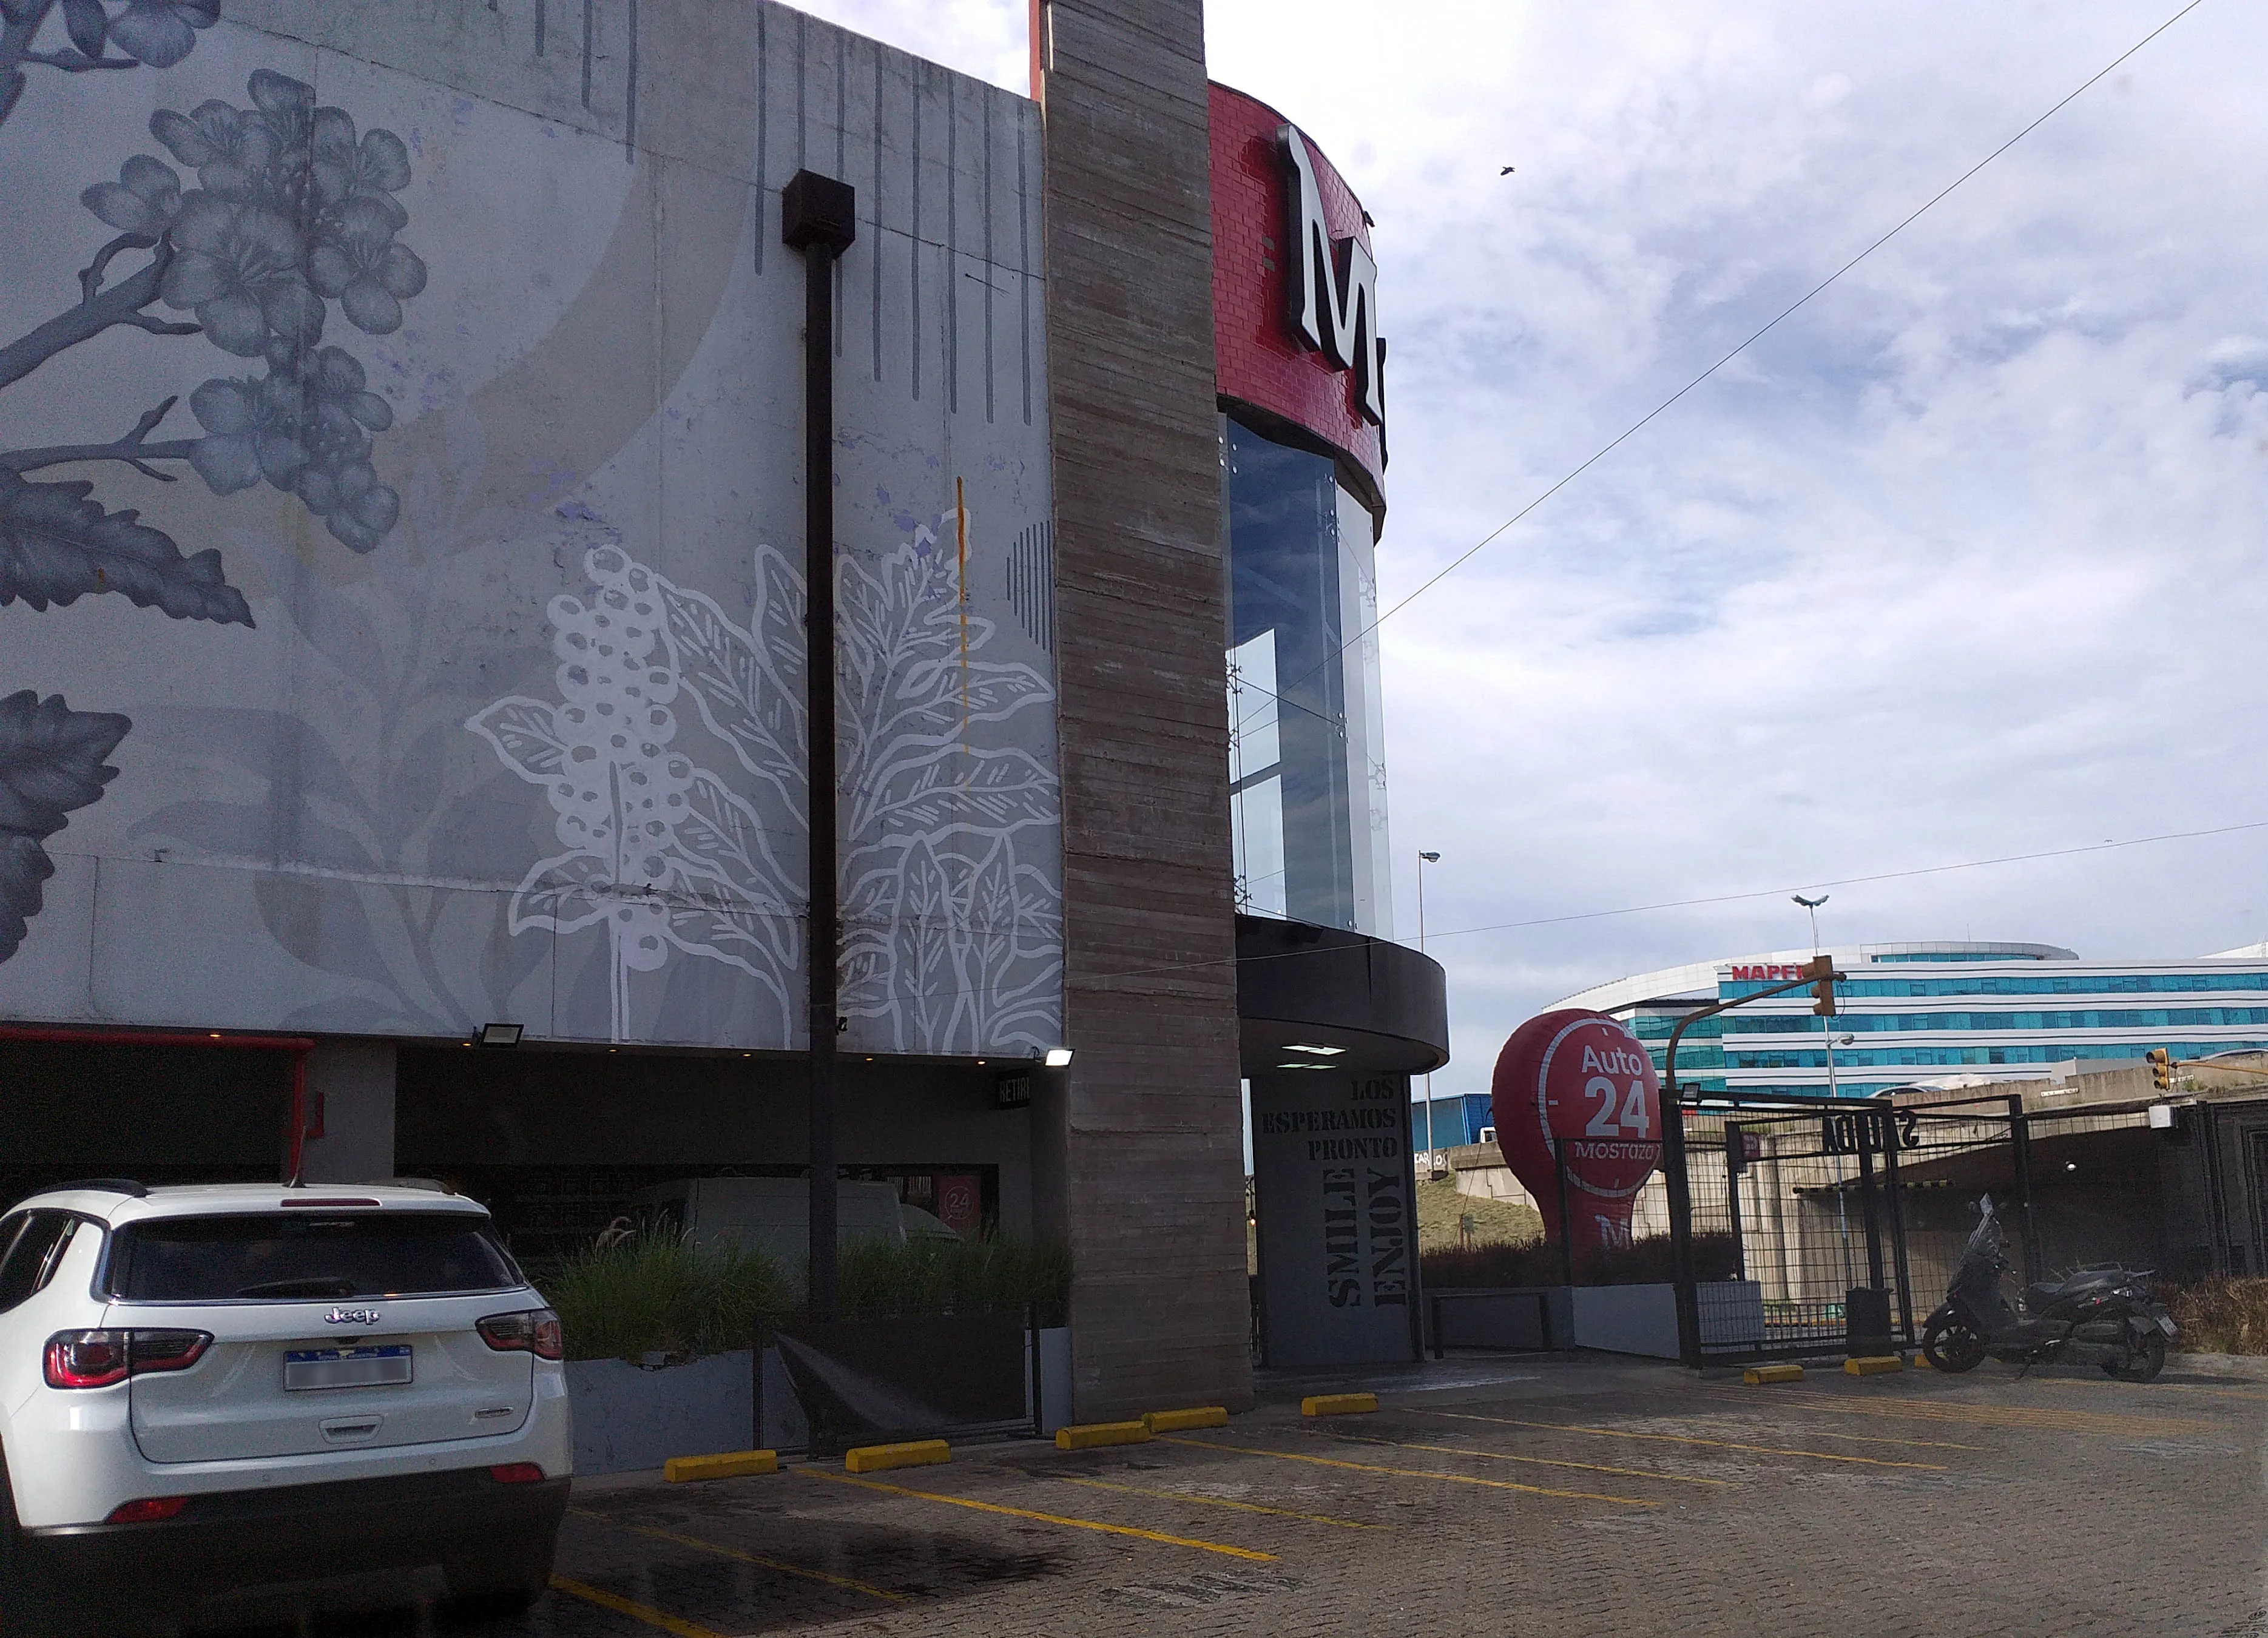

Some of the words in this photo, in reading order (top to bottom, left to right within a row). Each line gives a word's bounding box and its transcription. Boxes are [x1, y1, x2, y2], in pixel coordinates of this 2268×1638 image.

[1581, 1045, 1642, 1076] Auto
[1351, 1079, 1394, 1100] LOS
[1584, 1076, 1650, 1139] 24
[1261, 1108, 1396, 1134] ESPERAMOS
[1308, 1137, 1398, 1161] PRONTO
[950, 1193, 969, 1208] 24
[1322, 1167, 1362, 1308] SMILE
[1366, 1167, 1406, 1307] ENJOY
[324, 1306, 380, 1326] Jeep
